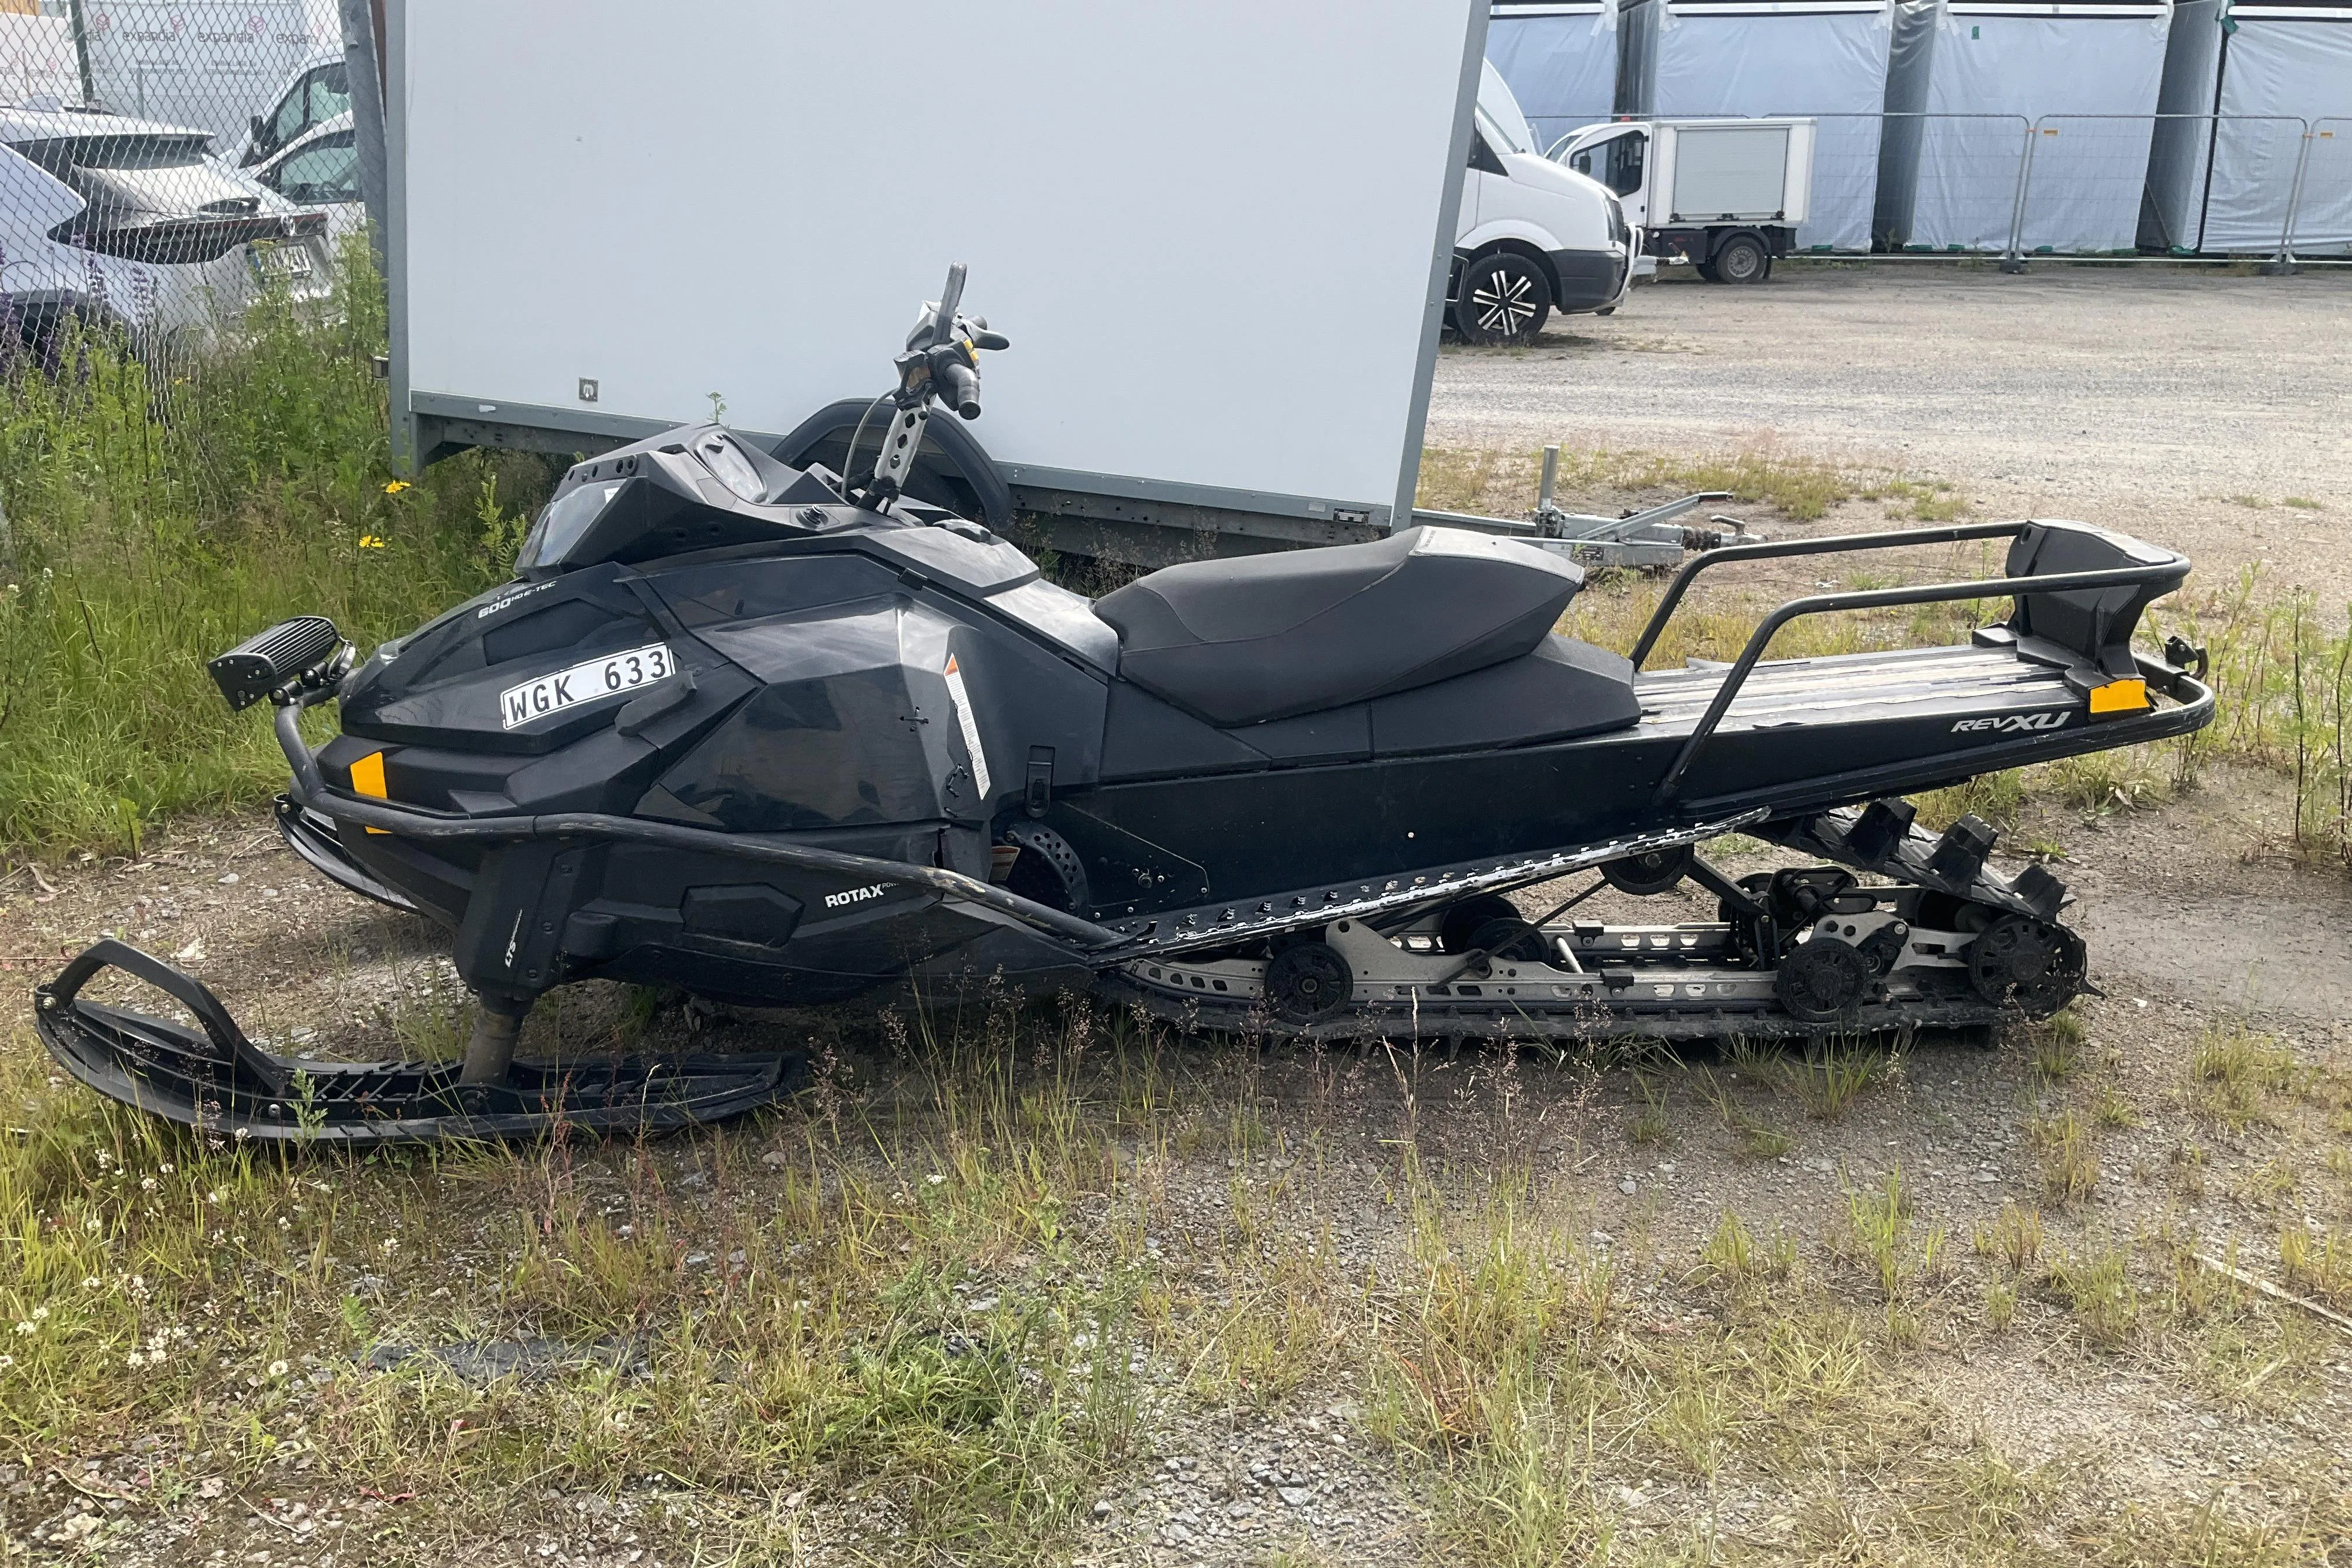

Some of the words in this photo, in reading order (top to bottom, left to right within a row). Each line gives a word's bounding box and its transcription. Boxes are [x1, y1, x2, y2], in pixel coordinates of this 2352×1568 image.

[197, 30, 255, 45] expandia
[509, 674, 575, 722] WGK
[605, 650, 666, 690] 633
[1950, 711, 2071, 733] REVXU
[824, 883, 884, 908] ROTAX
[505, 940, 516, 968] LTS
